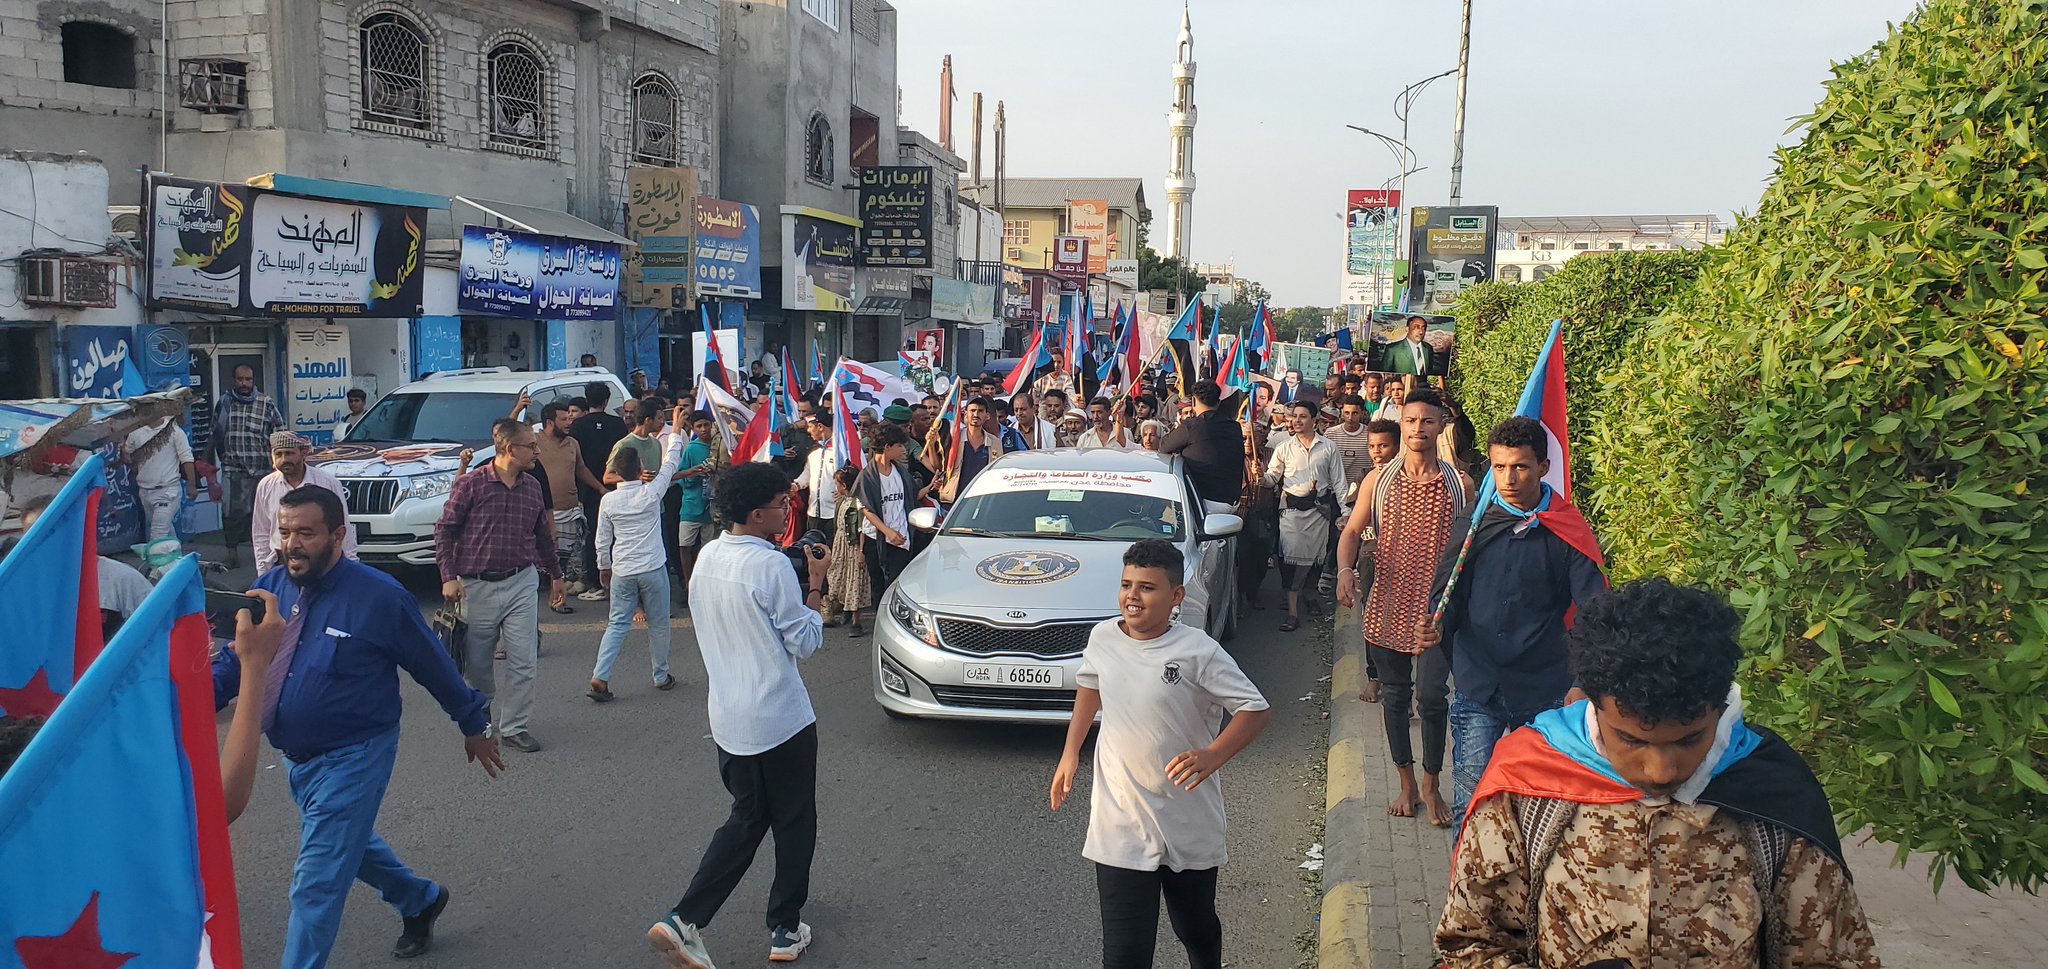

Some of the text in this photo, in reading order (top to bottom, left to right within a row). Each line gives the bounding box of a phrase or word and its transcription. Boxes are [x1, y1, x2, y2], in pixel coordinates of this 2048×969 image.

[863, 169, 928, 189] الإمارات
[166, 186, 212, 217] المهند
[633, 178, 684, 205] الاسطورة
[865, 190, 925, 211] تيليكوم
[637, 203, 682, 233] فون
[698, 205, 741, 229] الاسطورة
[1074, 219, 1104, 233] صيدلية
[278, 207, 363, 256] المهند
[1432, 234, 1460, 243] مخلوط
[318, 255, 367, 277] للسفريات
[540, 246, 616, 277] ورشة البرق
[465, 266, 534, 289] ورشة البرق
[463, 286, 531, 305] لصيانة الجوال
[539, 286, 614, 311] لصيانة الجوال
[272, 305, 361, 314] AL-MOHAND FOR TRAVEL
[72, 337, 128, 391] صالون
[293, 357, 346, 378] المهند
[296, 386, 346, 403] للسفريات
[1003, 471, 1047, 481] والتجارة
[1092, 472, 1118, 480] وزارة
[1094, 480, 1132, 488] محافظة
[1121, 471, 1152, 483] مكتب
[967, 668, 989, 678] عدن
[1010, 668, 1051, 683] 68566
